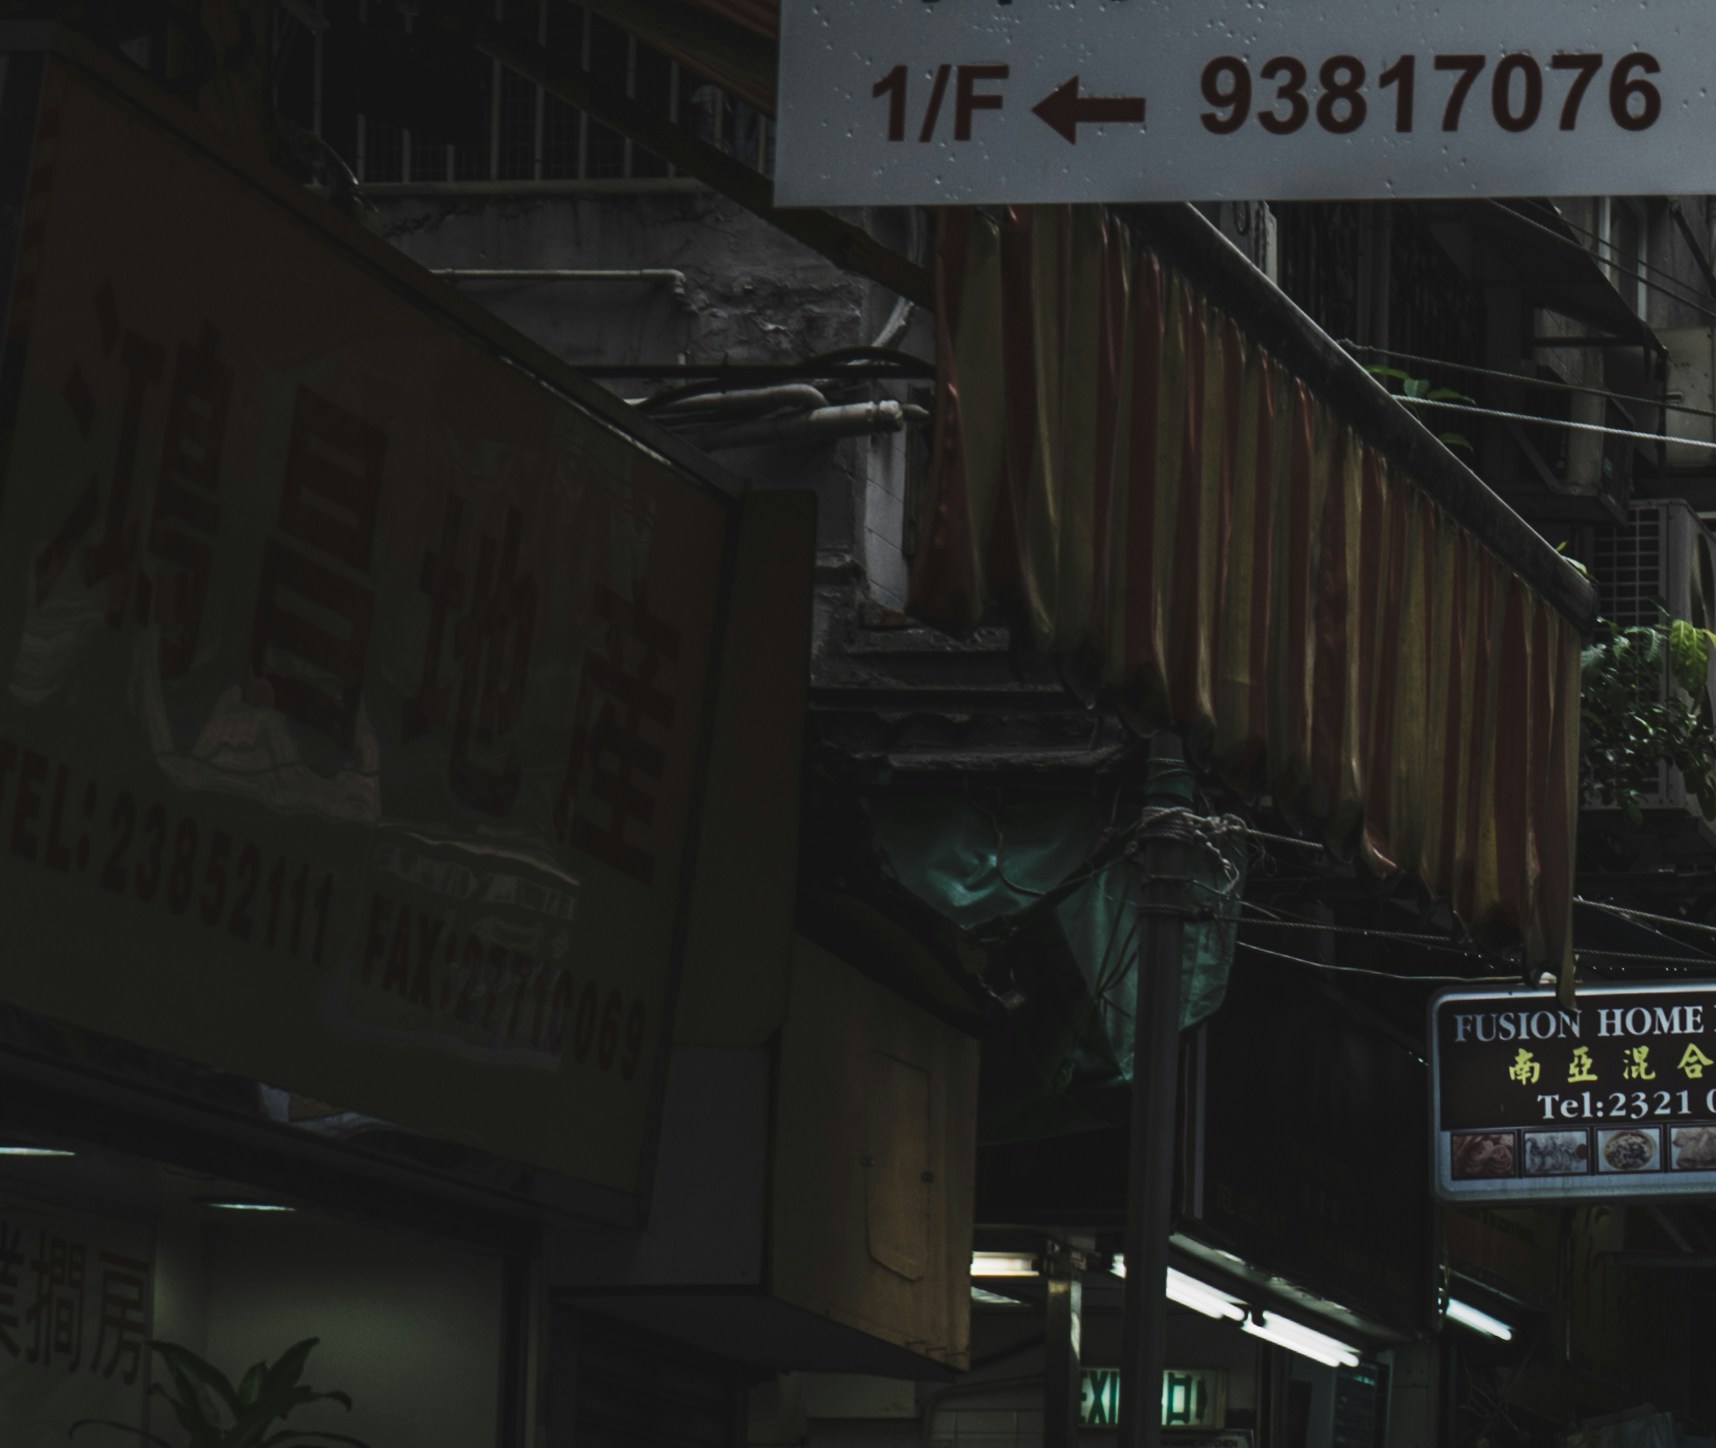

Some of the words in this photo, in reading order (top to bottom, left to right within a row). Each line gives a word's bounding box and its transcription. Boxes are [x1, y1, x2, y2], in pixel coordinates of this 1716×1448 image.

[872, 64, 1010, 143] 1/F
[1199, 52, 1663, 134] 93817076
[1453, 1009, 1582, 1042] FUSION
[1597, 1005, 1705, 1037] HOME
[1537, 1089, 1692, 1119] Tel:2321
